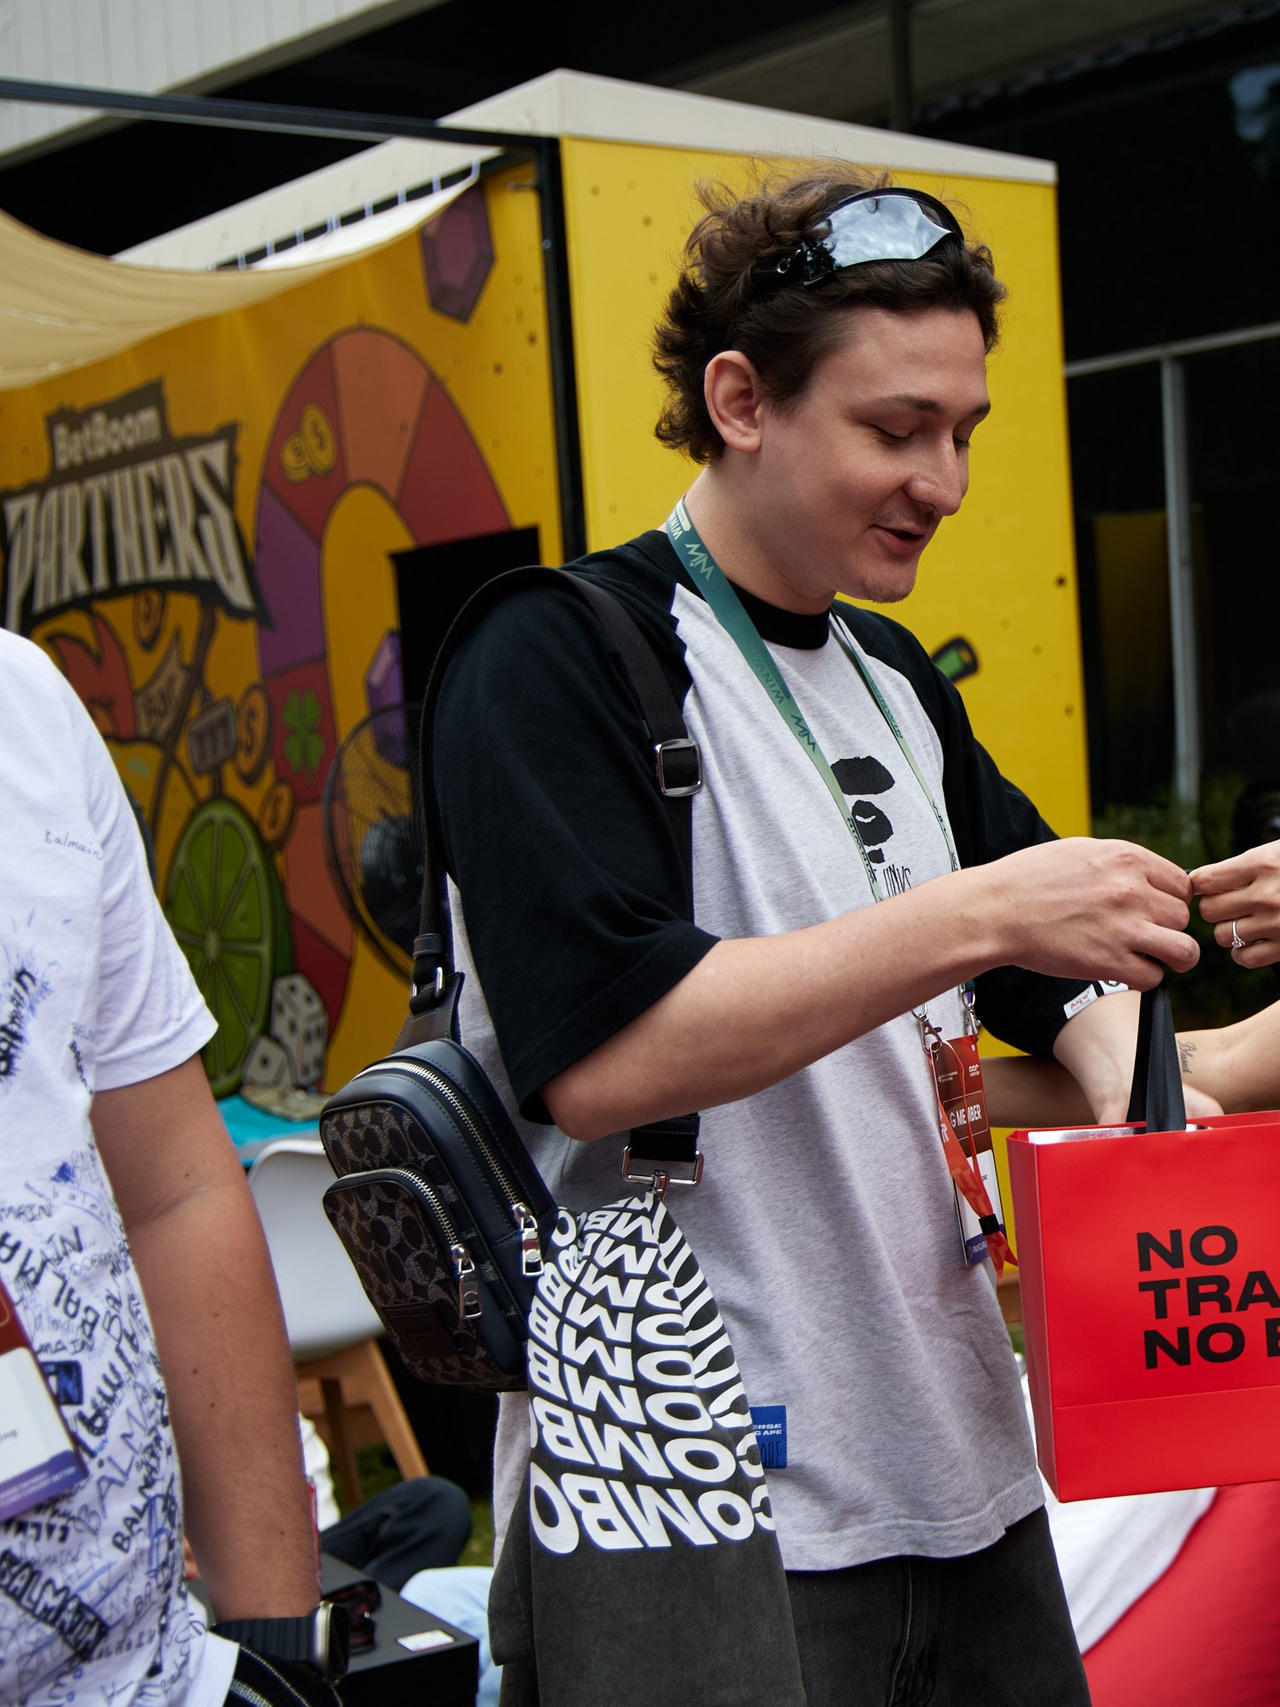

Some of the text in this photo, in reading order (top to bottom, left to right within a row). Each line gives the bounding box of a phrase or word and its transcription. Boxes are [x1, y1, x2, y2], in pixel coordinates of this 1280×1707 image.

[53, 405, 162, 472] BetBoom
[3, 438, 257, 637] PARTNERS
[1136, 1225, 1239, 1272] NO
[1143, 1321, 1246, 1370] NO
